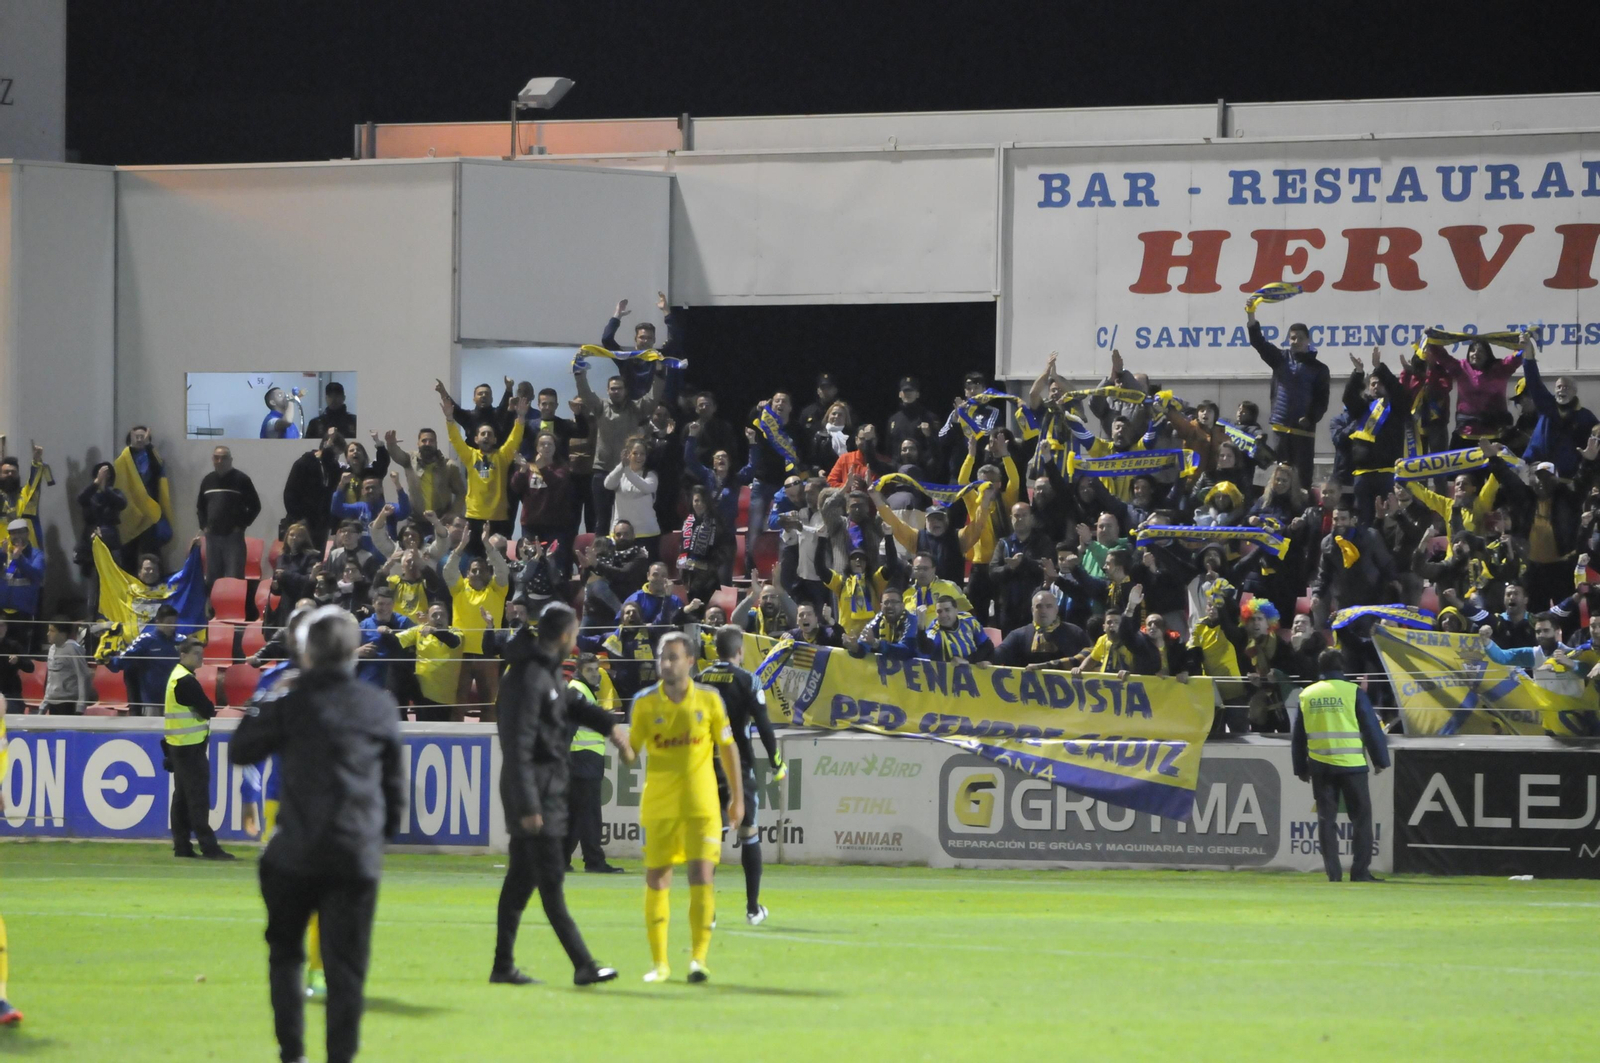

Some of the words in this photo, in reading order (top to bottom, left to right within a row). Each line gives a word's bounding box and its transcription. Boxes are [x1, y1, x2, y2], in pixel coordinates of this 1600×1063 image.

[1037, 172, 1160, 208] BAR
[1129, 223, 1600, 294] HERVI
[1096, 324, 1119, 351] C/
[1121, 457, 1162, 468] SEMPRE
[1404, 451, 1463, 473] CADIZ
[992, 668, 1153, 719] CADISTA
[1310, 697, 1344, 707] GARDA
[813, 755, 859, 776] RAIN
[878, 756, 922, 777] BIRD
[836, 796, 898, 815] STIHL
[1011, 779, 1268, 835] GRUMA
[1407, 772, 1600, 830] ALEJ
[834, 830, 903, 846] YANMAR
[948, 839, 1026, 850] REPARACIÓN
[1029, 841, 1045, 850] DE
[1095, 843, 1104, 851] Y
[1106, 843, 1184, 853] MAQUINARIA
[1187, 845, 1204, 854] EN
[1207, 845, 1267, 855] GENERAL
